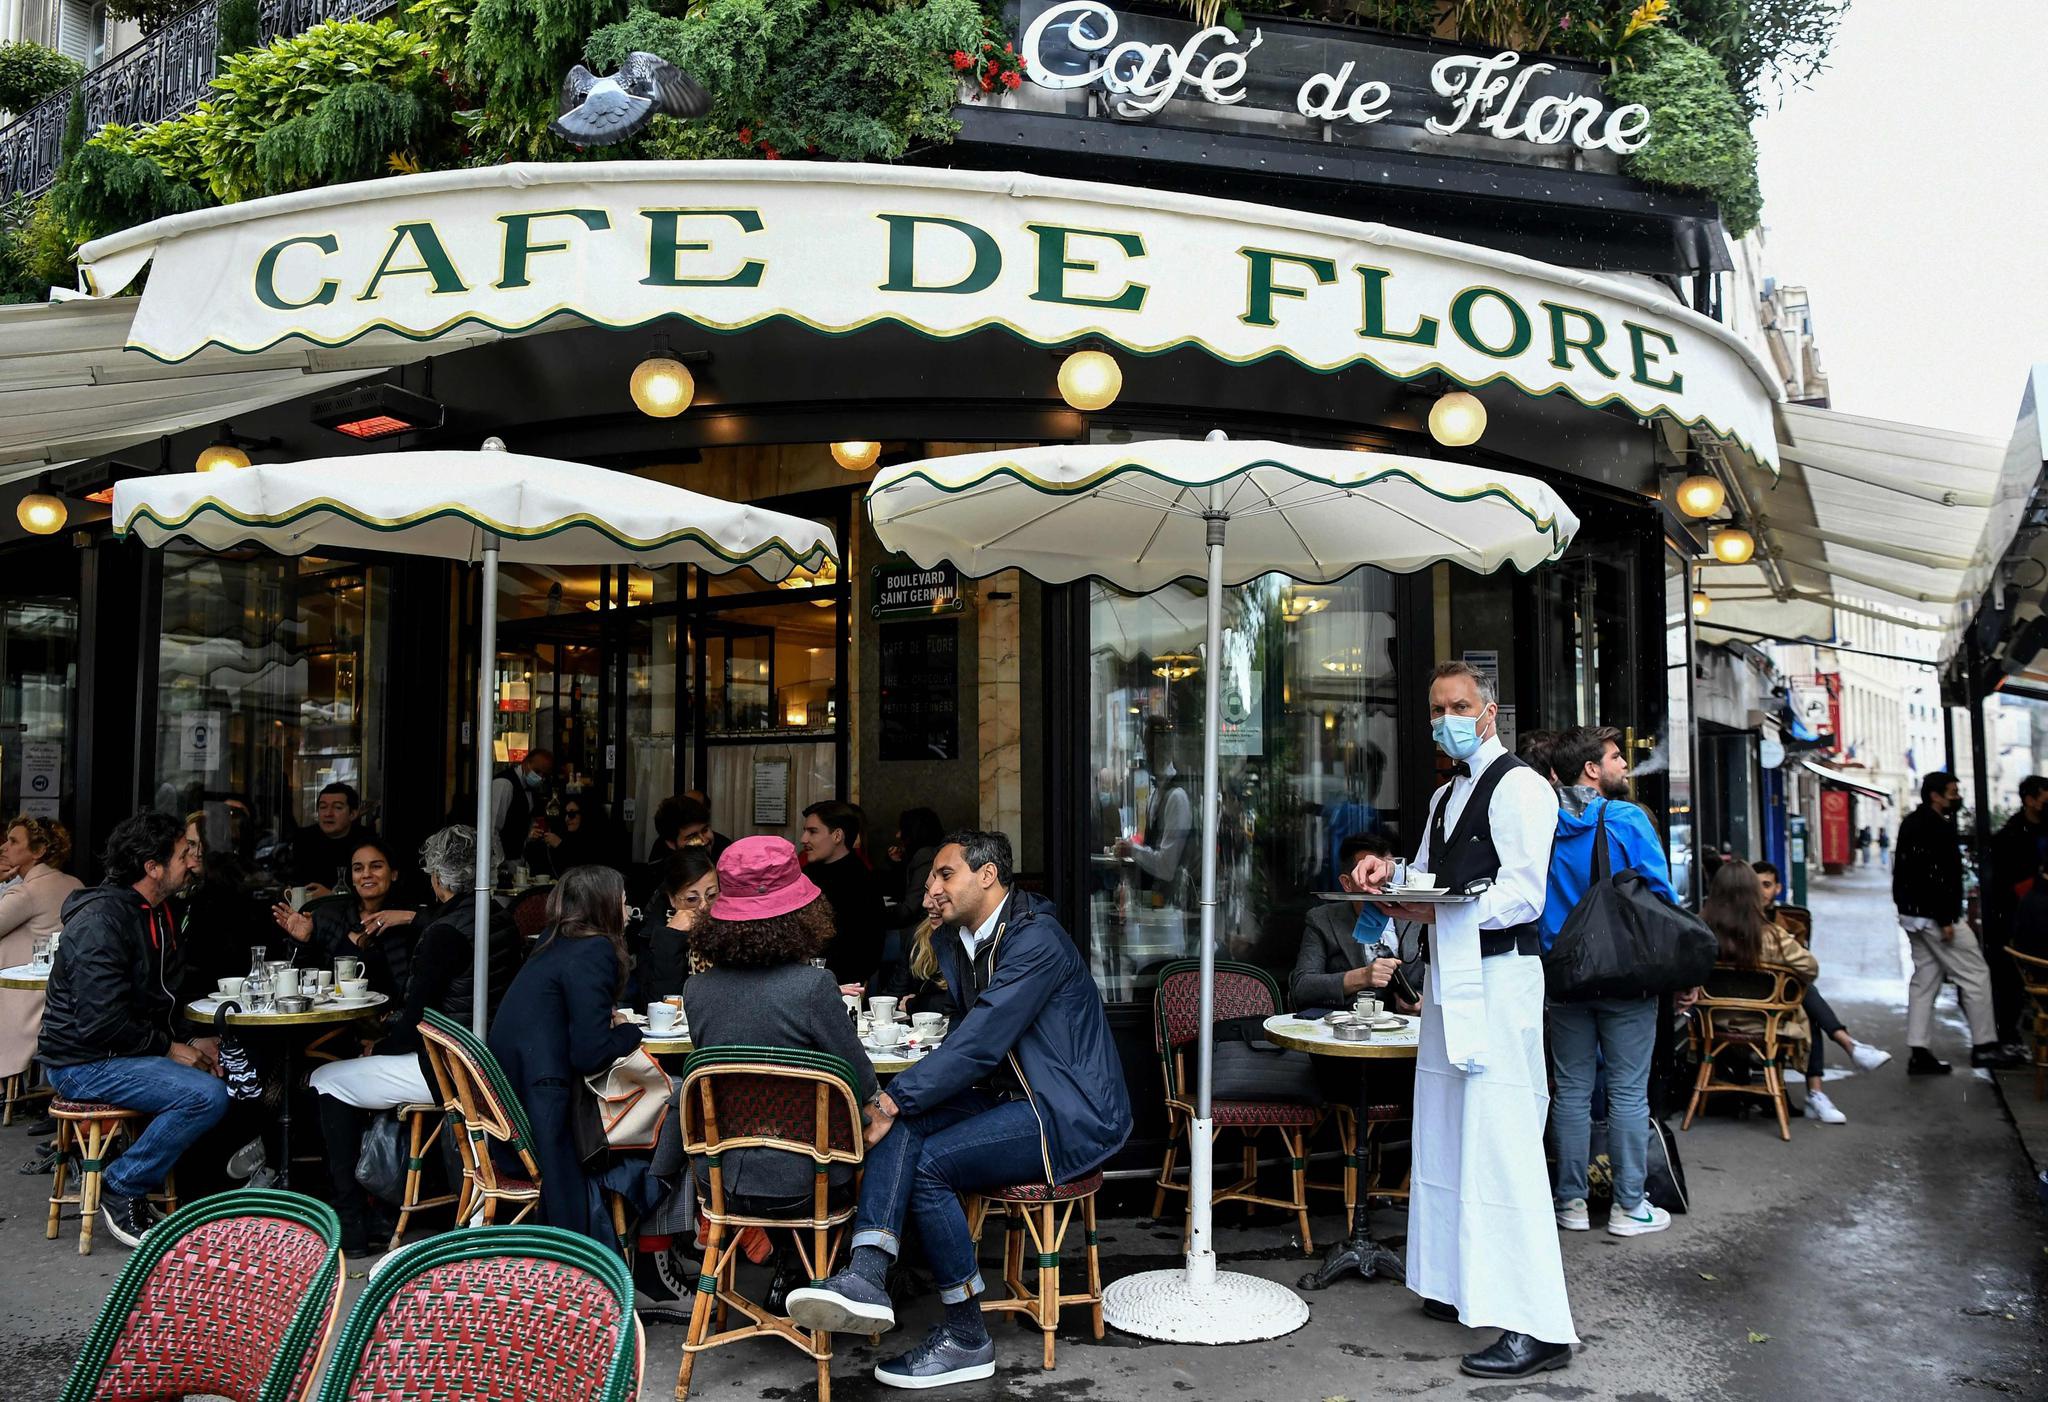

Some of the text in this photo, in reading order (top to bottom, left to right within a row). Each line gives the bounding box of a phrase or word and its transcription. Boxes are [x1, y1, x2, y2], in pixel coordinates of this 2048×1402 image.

[1021, 0, 1653, 155] Café de Flore
[254, 208, 1684, 395] CAFE DE FLORE
[887, 570, 946, 589] BOULEVARD
[880, 586, 954, 605] SAINT GERMAIN
[927, 638, 954, 653] FLORE
